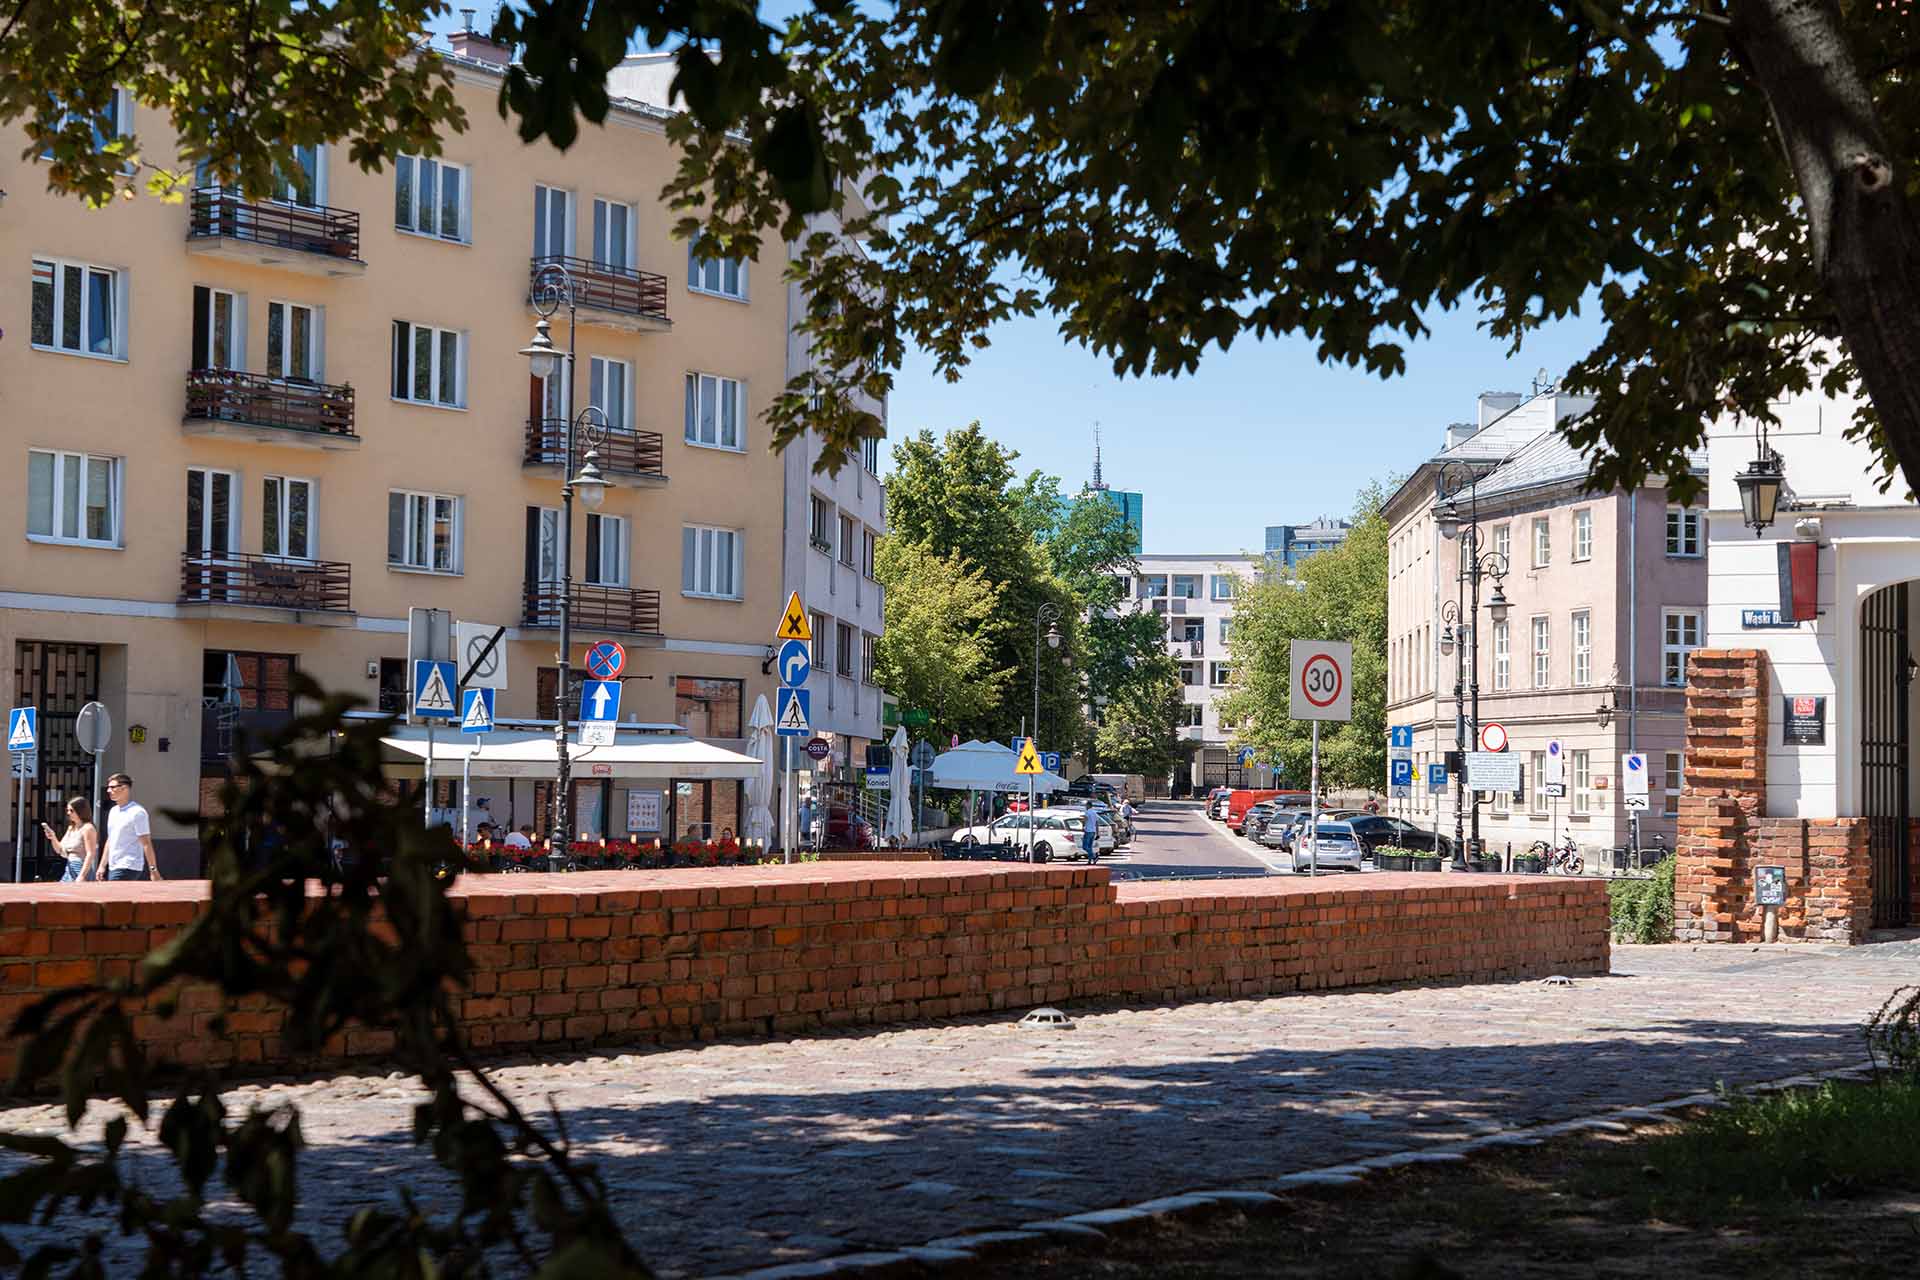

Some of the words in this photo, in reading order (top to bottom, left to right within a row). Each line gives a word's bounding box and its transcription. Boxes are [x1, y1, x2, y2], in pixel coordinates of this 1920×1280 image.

[1744, 610, 1771, 626] Wąski
[1308, 667, 1335, 693] 30
[1047, 757, 1056, 769] P
[1395, 761, 1408, 778] P
[866, 777, 889, 787] Koniec
[1432, 766, 1444, 782] P
